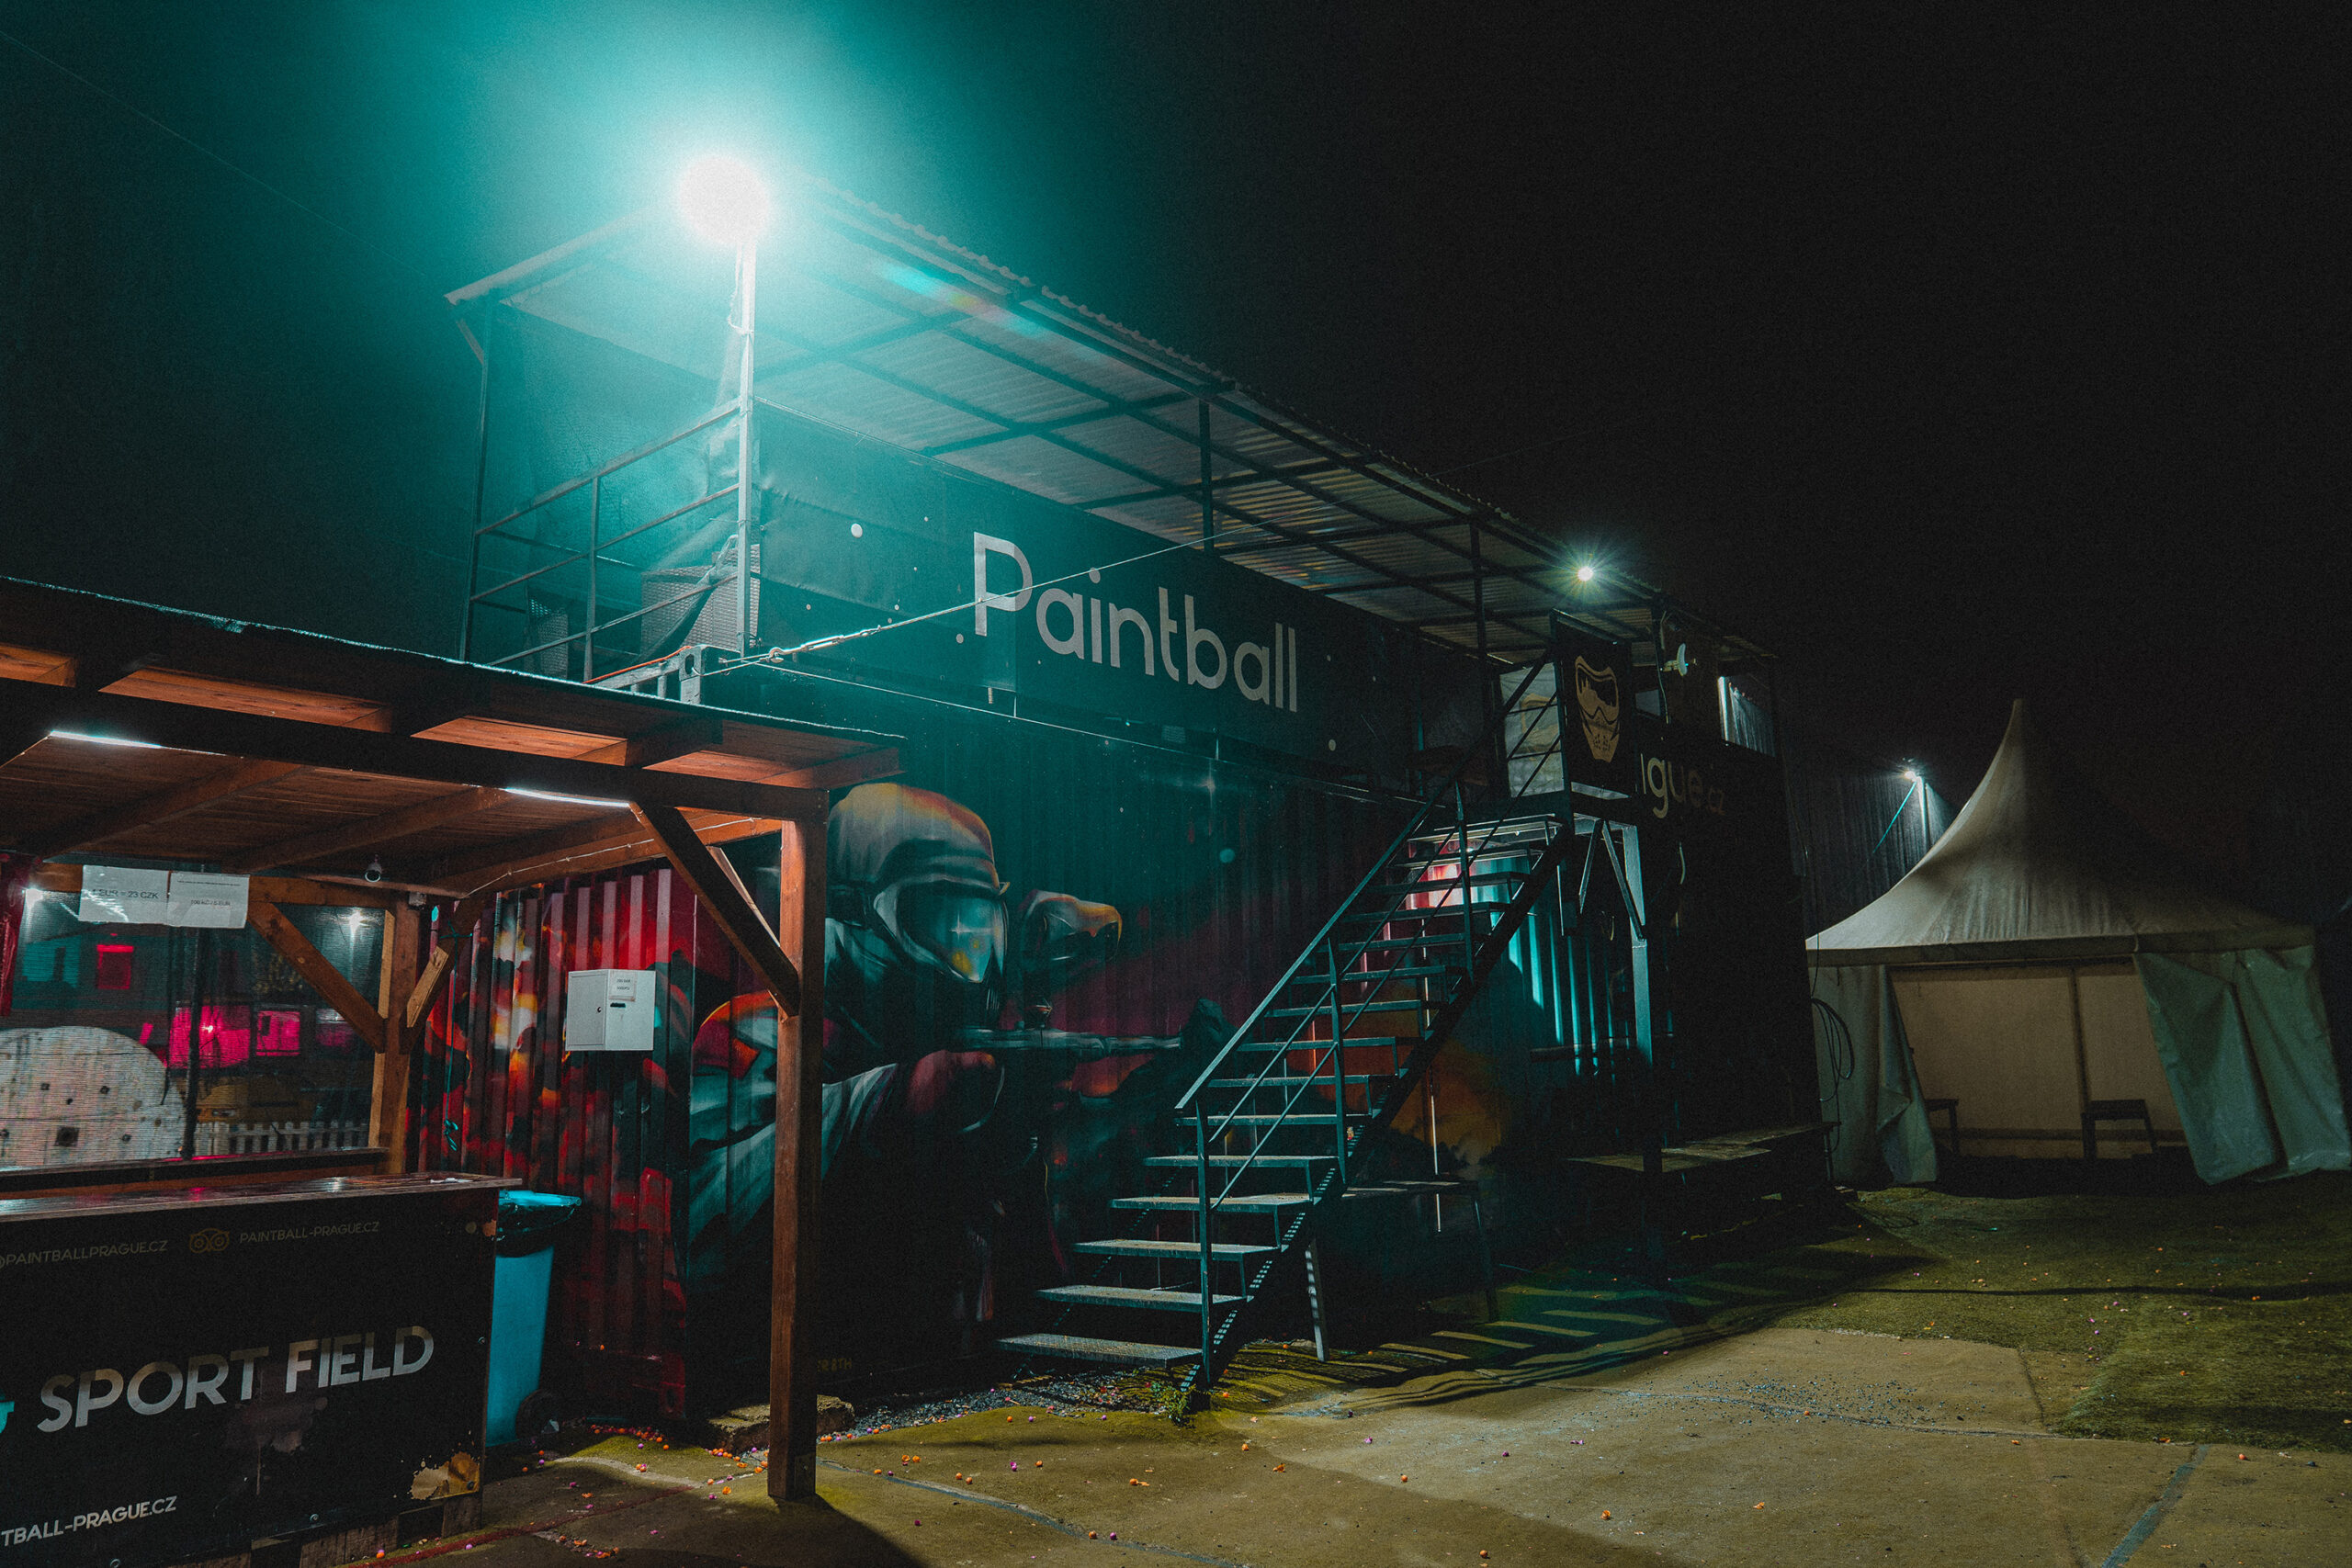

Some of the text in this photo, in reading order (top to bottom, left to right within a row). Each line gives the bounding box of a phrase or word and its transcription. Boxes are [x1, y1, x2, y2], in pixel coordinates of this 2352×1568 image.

[974, 532, 1297, 713] Paintball
[98, 888, 119, 897] EUR
[128, 890, 139, 898] 23
[140, 891, 159, 899] CZK
[240, 1221, 380, 1244] PAINTBALL-PRAGUE.CZ
[37, 1346, 270, 1433] SPORT
[285, 1325, 435, 1393] FIELD
